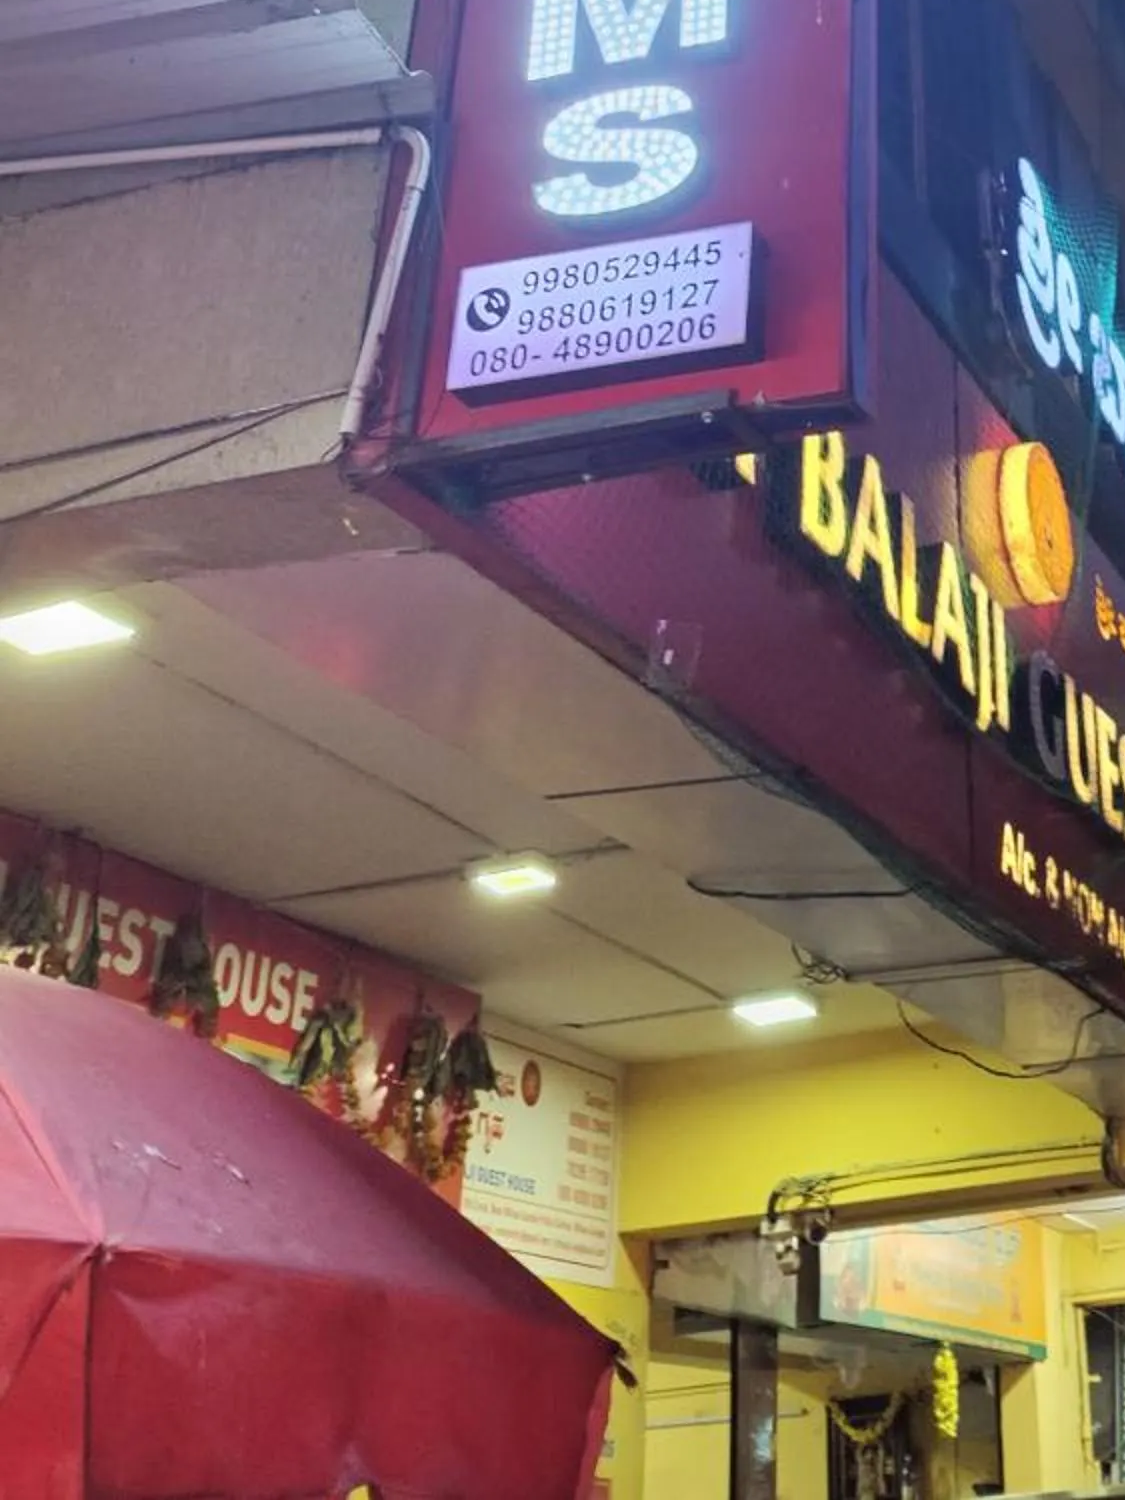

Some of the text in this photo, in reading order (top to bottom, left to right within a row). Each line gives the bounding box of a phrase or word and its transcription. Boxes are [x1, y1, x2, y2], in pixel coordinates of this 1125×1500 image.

[522, 240, 722, 296] 9980529445
[517, 279, 720, 336] 9880619127
[553, 312, 717, 362] 48900206
[800, 430, 1010, 732] BALAJI
[56, 882, 319, 1032] UEST OUSE
